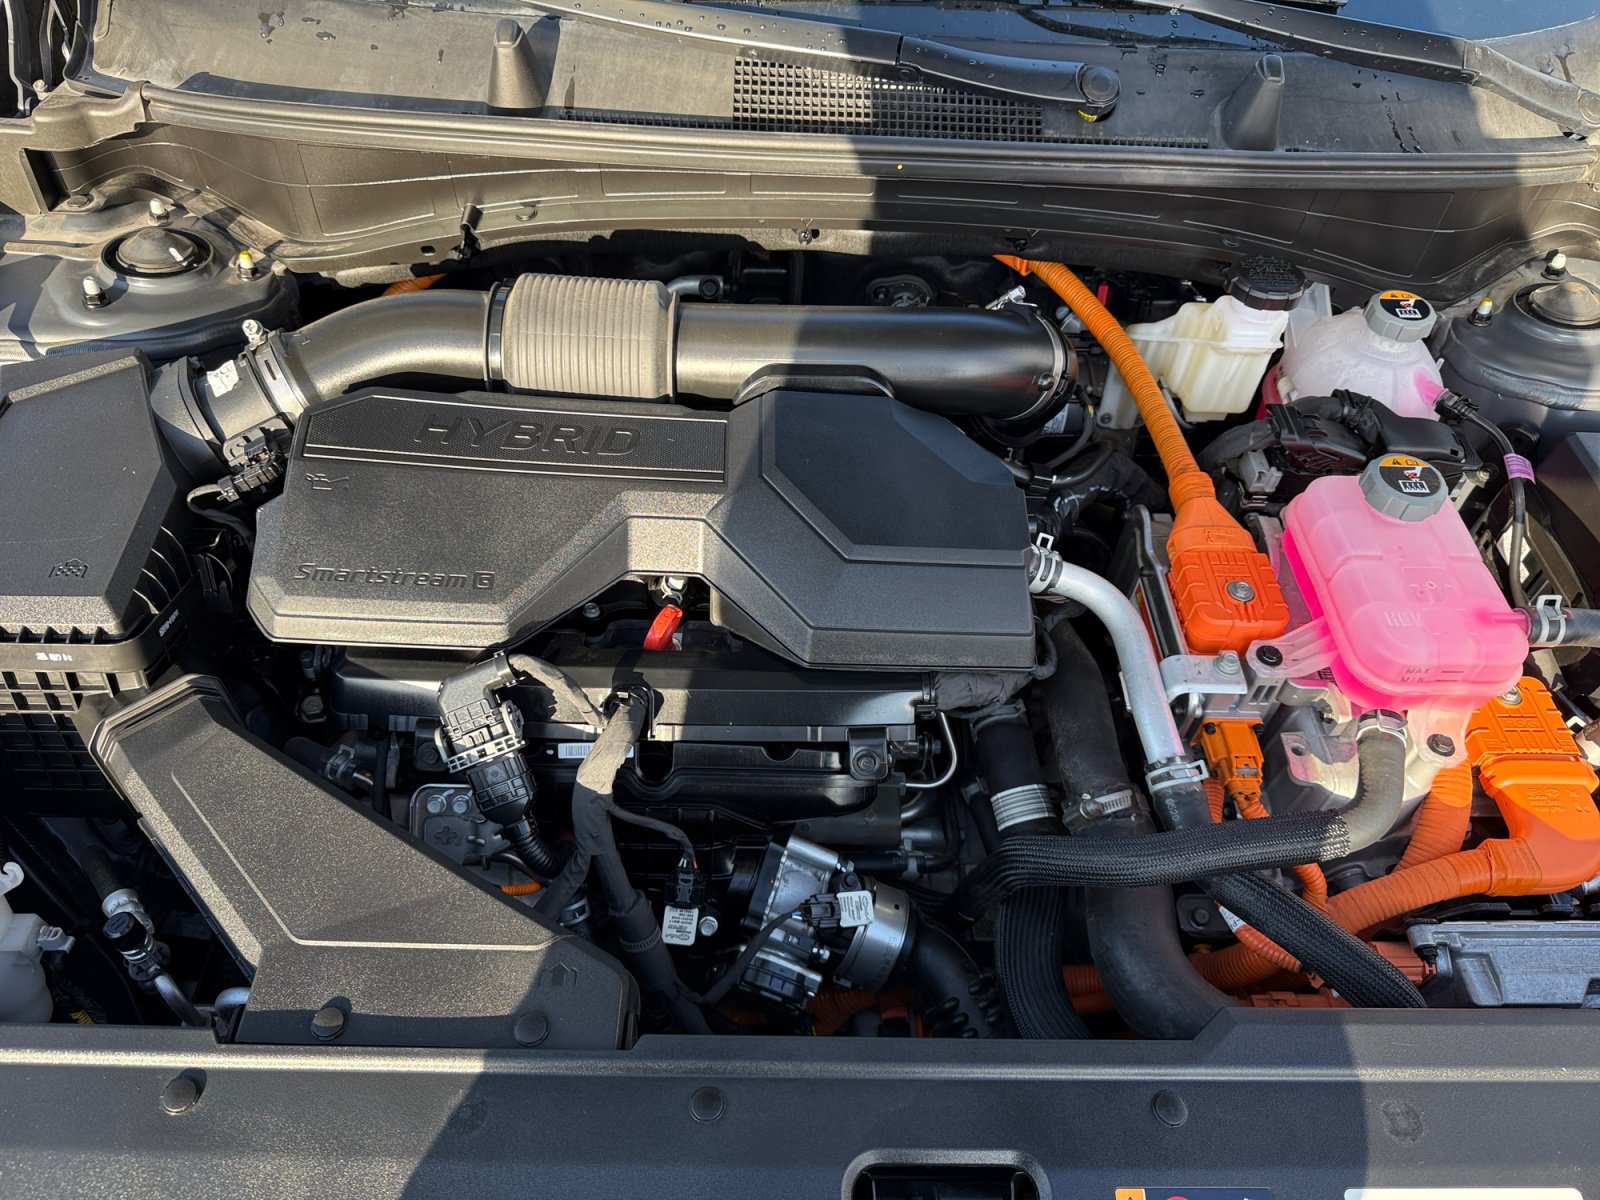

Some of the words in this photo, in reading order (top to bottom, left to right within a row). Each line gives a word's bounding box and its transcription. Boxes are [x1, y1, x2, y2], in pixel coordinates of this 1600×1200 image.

[413, 414, 641, 456] HYBRID
[293, 562, 468, 588] Smartstream
[472, 570, 496, 590] G
